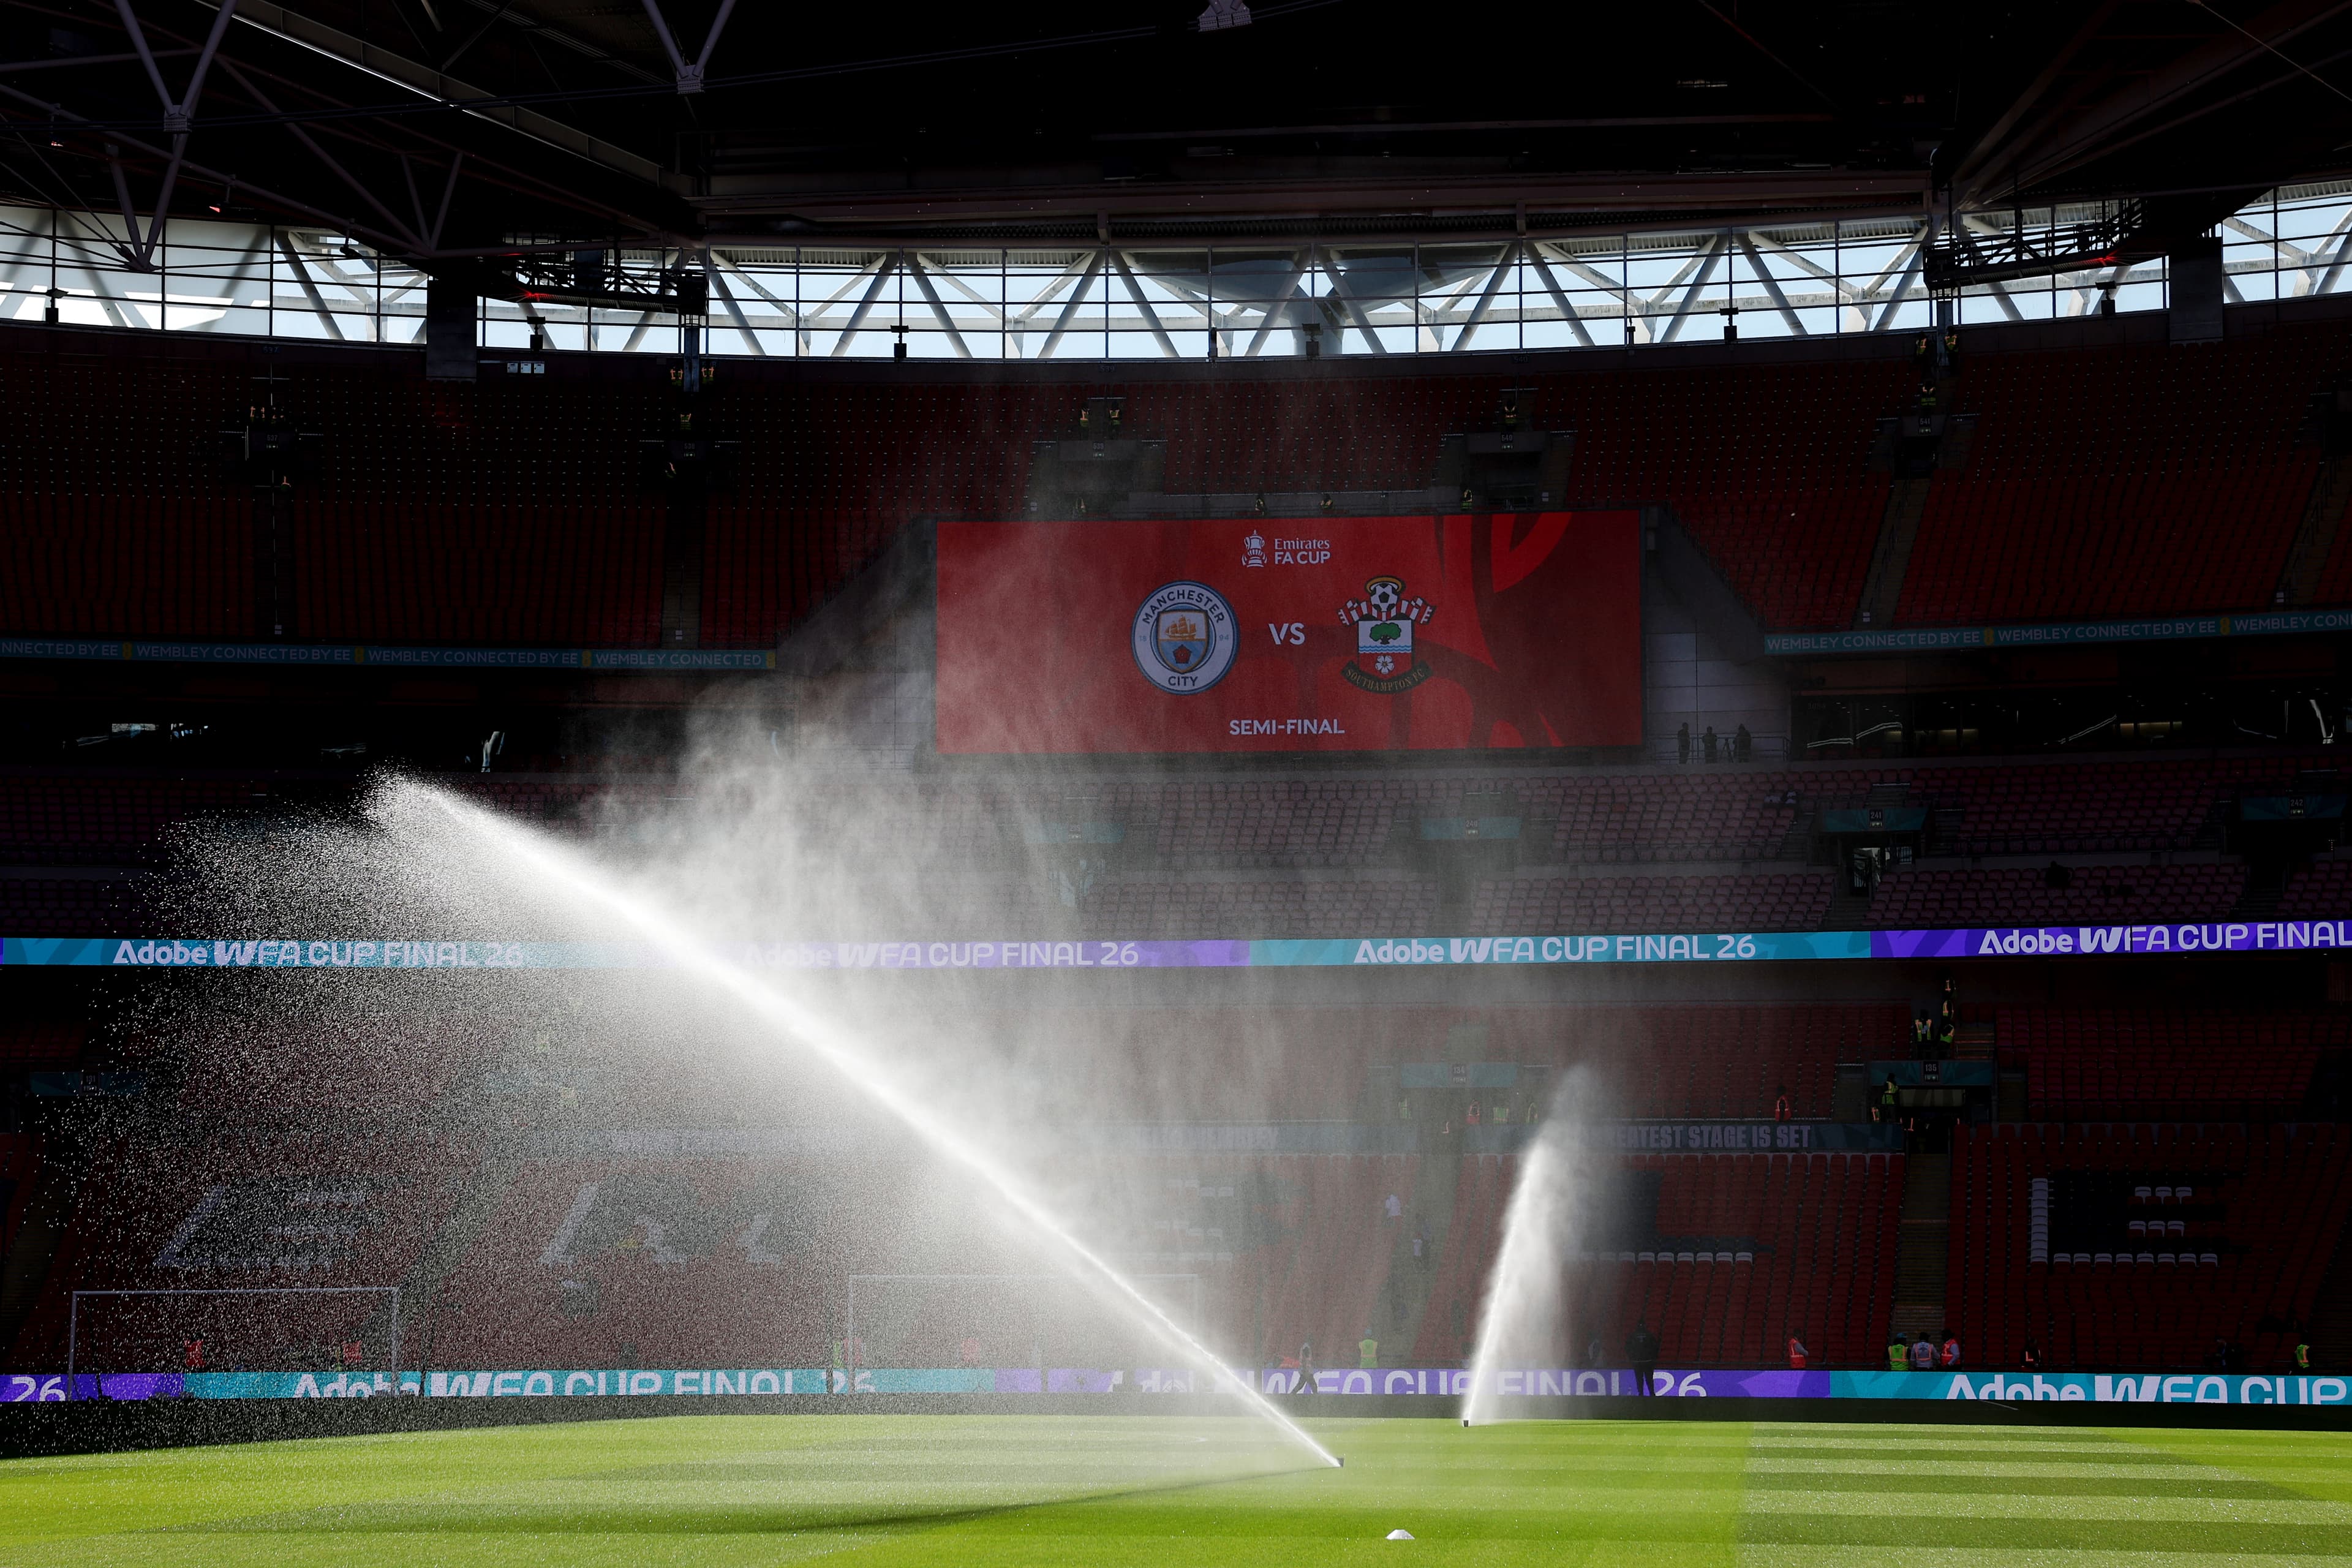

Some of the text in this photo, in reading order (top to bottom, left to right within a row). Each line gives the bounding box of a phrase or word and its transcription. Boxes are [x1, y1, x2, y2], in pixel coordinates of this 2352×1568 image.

[1275, 537, 1330, 549] Emirates
[1275, 551, 1330, 564] FA CUP
[1142, 589, 1225, 624] MANCHESTER
[1268, 622, 1306, 646] VS
[1998, 621, 2216, 642] WEMBLEY CONNECTED BY EE
[2234, 615, 2311, 631] WEMBLEY
[79, 644, 98, 655] BY
[102, 645, 118, 656] EE
[1767, 631, 1980, 650] WEMBLEY CONNECTED BY EE
[137, 645, 351, 660] WEMBLEY CONNECTED BY EE
[368, 650, 579, 664] WEMBLEY CONNECTED BY EE
[595, 654, 761, 666] WEMBLEY CONNECTED
[1168, 676, 1199, 687] CITY
[1346, 668, 1412, 692] SOUTHAMPTON
[1229, 719, 1345, 735] SEMI-FINAL
[1354, 938, 1444, 963] Adobe
[1541, 937, 1610, 961] CUP
[1616, 935, 1711, 960] FINAL
[1716, 934, 1757, 959] 26
[1978, 928, 2073, 955] Adobe
[2176, 923, 2249, 950] CUP
[112, 940, 208, 965] Adobe
[307, 941, 379, 967] CUP
[383, 942, 478, 967] FINAL
[485, 942, 524, 966] 26
[928, 942, 996, 967] CUP
[1002, 942, 1094, 967] FINAL
[1100, 941, 1139, 966] 26
[1689, 1126, 1747, 1148] STAGE
[1752, 1125, 1771, 1148] IS
[1776, 1125, 1811, 1148] SET
[11, 1375, 67, 1401] 26
[565, 1371, 663, 1395] CUP
[1653, 1371, 1708, 1397] 26
[1946, 1374, 2086, 1401] Adobe
[2240, 1376, 2347, 1405] CUP
